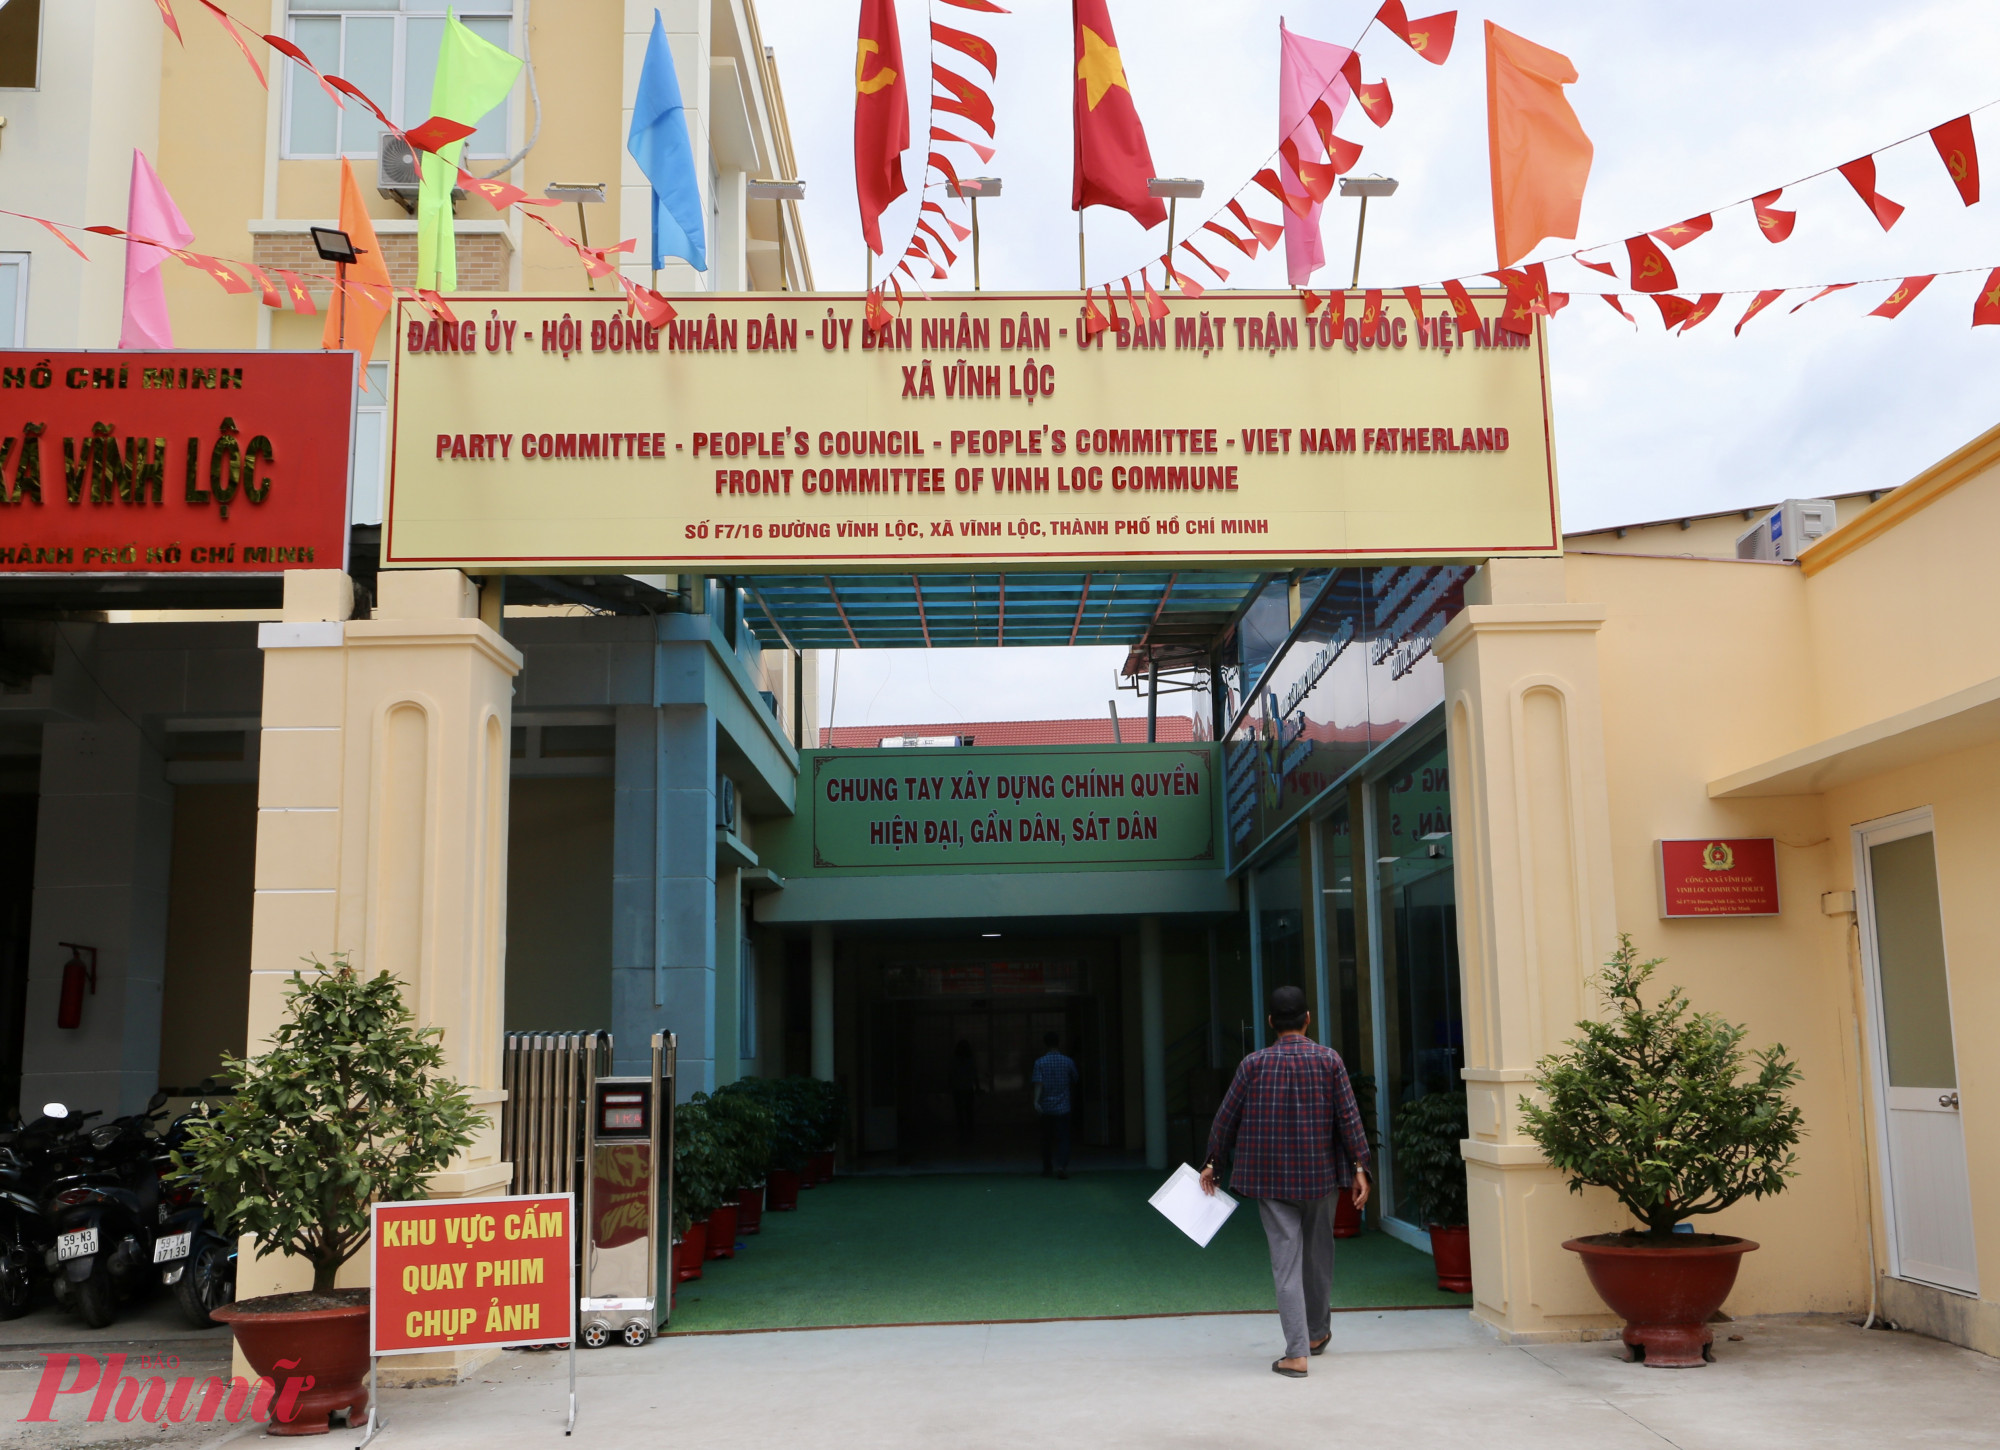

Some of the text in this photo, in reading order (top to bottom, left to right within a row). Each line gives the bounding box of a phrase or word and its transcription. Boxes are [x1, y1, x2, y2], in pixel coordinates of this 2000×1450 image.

[485, 309, 517, 351] ỦY
[541, 312, 582, 359] HỘI
[591, 309, 660, 352] ĐỒNG
[668, 313, 738, 351] NHÂN
[746, 313, 798, 351] DÂN
[822, 307, 853, 350] ỦY
[921, 312, 990, 350] NHÂN
[1000, 311, 1050, 349] DÂN
[1116, 317, 1167, 348] BAN
[1175, 310, 1226, 356] MẶT
[1234, 311, 1299, 355] TRẬN
[1415, 310, 1464, 354] VIỆT
[3, 359, 244, 389] HỒ CHÍ MINH
[902, 358, 1055, 404] XÃ VĨNH LỘC
[436, 434, 513, 459] PARTY
[522, 433, 666, 458] COMMITTEE
[693, 426, 810, 457] PEOPLE'S
[819, 431, 925, 456] COUNCIL
[951, 425, 1067, 455] PEOPLE'S
[1076, 429, 1218, 454] COMMITTEE
[1242, 428, 1292, 453] VIET
[1300, 428, 1357, 453] NAM
[1363, 427, 1510, 452] FATHERLAND
[63, 421, 167, 504] VĨNH
[185, 417, 276, 520] LỘC
[716, 465, 1239, 495] FRONT COMMITTEE OF VINH LOC COMMUNE
[685, 515, 1269, 540] SỐ F7/16 ĐƯỜNG VĨNH LỘC, XÃ VĨNH LỘC, THÀNH PHỐ HỒ CHÍ MINH
[0, 542, 315, 565] HÀNH PHỐ HỒ CHÍ MINH
[826, 776, 898, 802] CHUNG
[905, 775, 944, 801] TAY
[950, 770, 990, 800] XÂY
[997, 774, 1054, 805] DỰNG
[1061, 767, 1124, 798] CHÍNH
[1131, 763, 1199, 797] QUYỀN
[870, 809, 1158, 851] HIỆN ĐẠI, GẦN DÂN, SÁT DÂN
[63, 1230, 92, 1246] 59-N3
[383, 1203, 563, 1248] KHU VỰC CẤM
[402, 1257, 544, 1295] QUAY PHIM
[406, 1297, 540, 1341] CHỤP ẢNH
